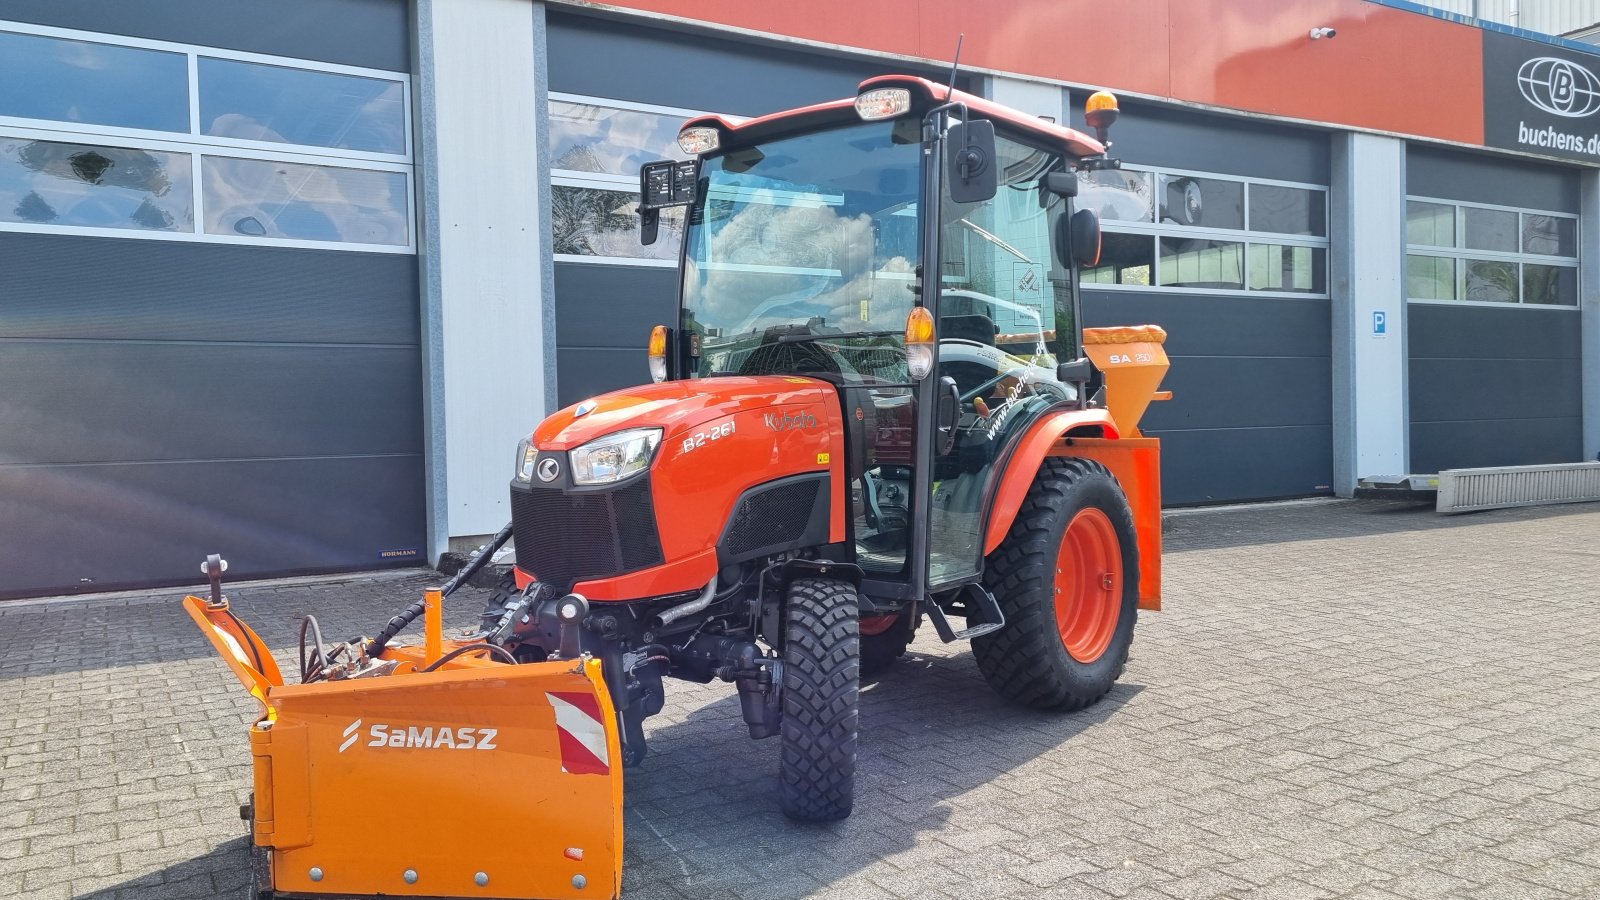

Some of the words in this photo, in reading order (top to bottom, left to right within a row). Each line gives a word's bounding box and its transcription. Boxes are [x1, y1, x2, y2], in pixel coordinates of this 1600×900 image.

[1374, 313, 1384, 331] P
[1109, 354, 1132, 364] SA
[987, 341, 1046, 440] www.buchens.de
[764, 409, 817, 431] Kubota
[683, 420, 736, 453] B2-261
[368, 724, 498, 750] SaMASZ
